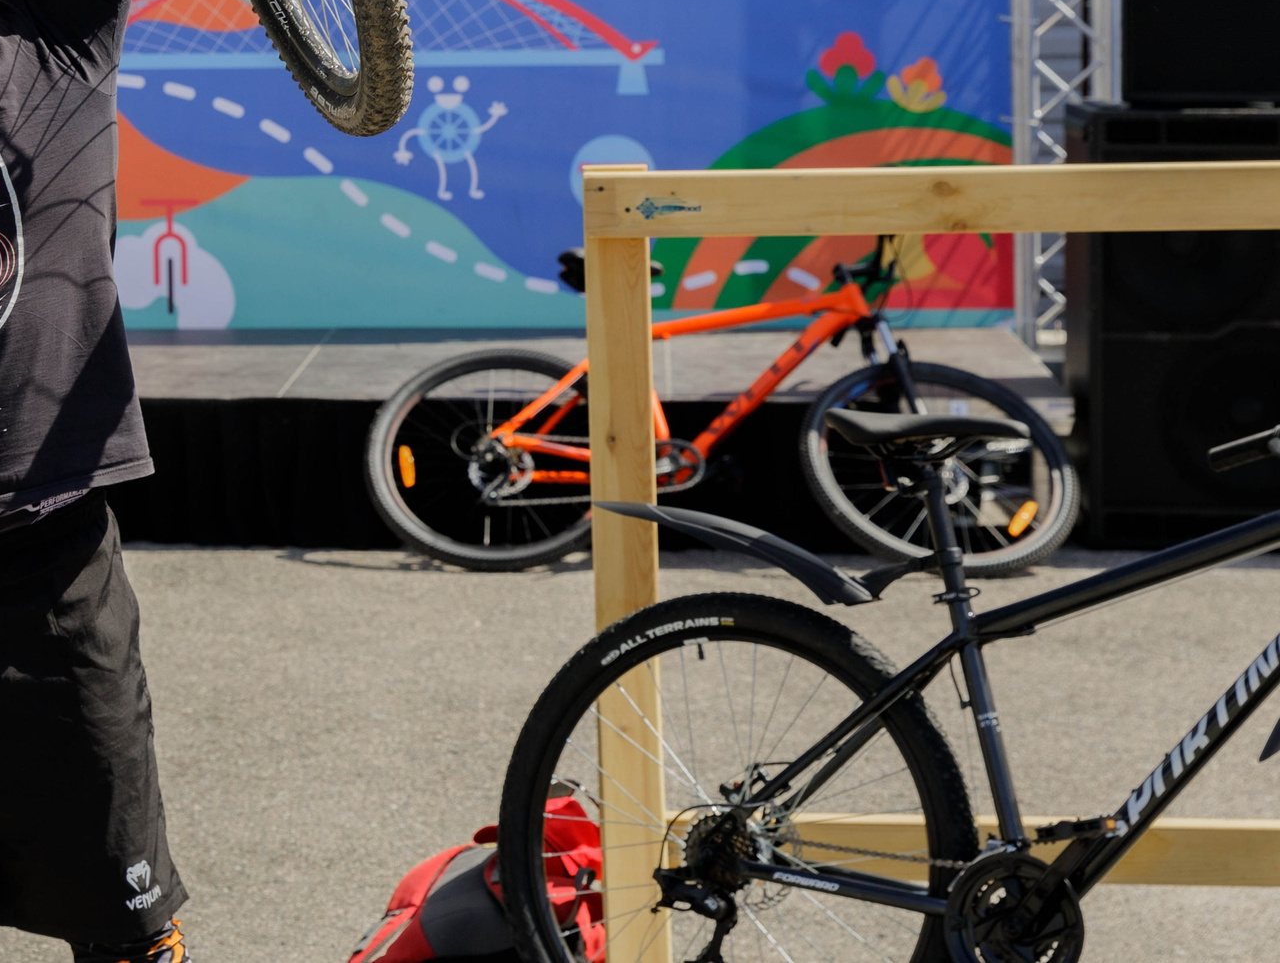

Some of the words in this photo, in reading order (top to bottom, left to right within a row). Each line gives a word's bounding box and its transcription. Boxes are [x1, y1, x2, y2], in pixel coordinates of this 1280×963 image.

[620, 635, 647, 654] ALL
[644, 616, 720, 639] TERRAINS
[772, 871, 841, 892] FORWARD
[125, 883, 162, 912] VENUM
